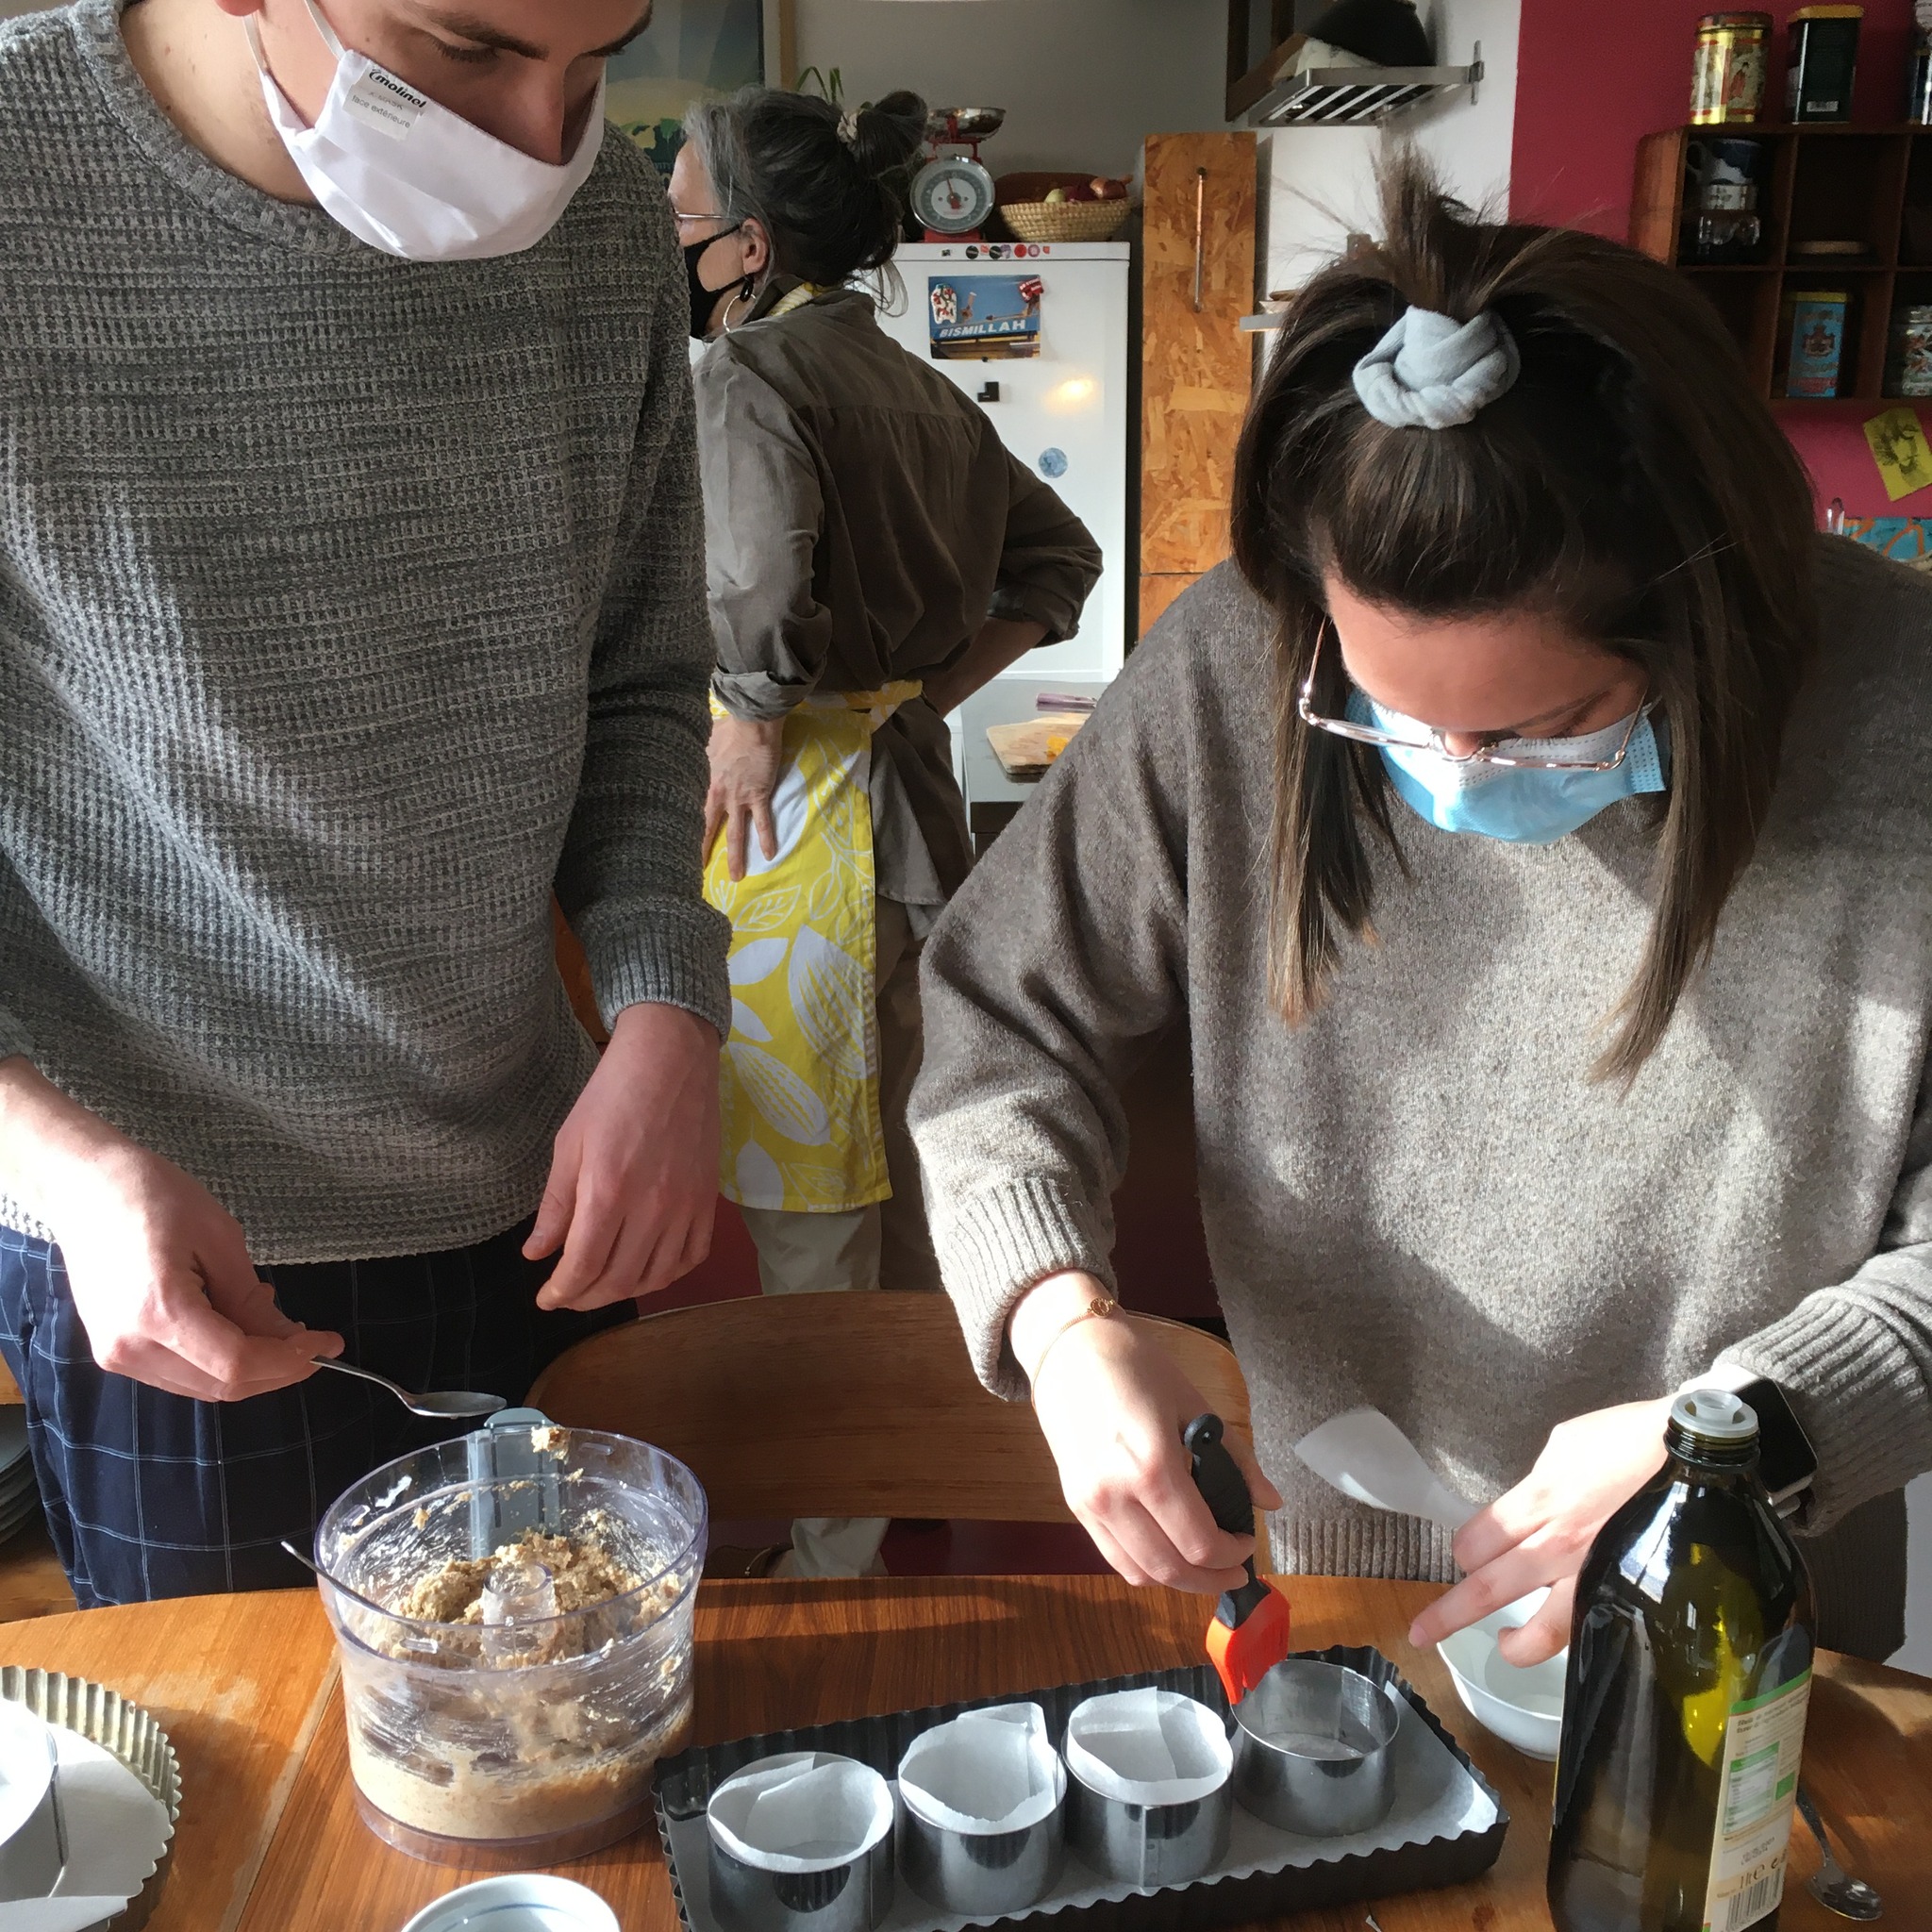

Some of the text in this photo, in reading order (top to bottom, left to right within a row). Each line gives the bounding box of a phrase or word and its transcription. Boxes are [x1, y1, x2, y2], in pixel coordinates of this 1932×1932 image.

[370, 71, 426, 108] molinel
[352, 95, 410, 128] face extérieure
[940, 319, 1026, 338] BISMILLAH
